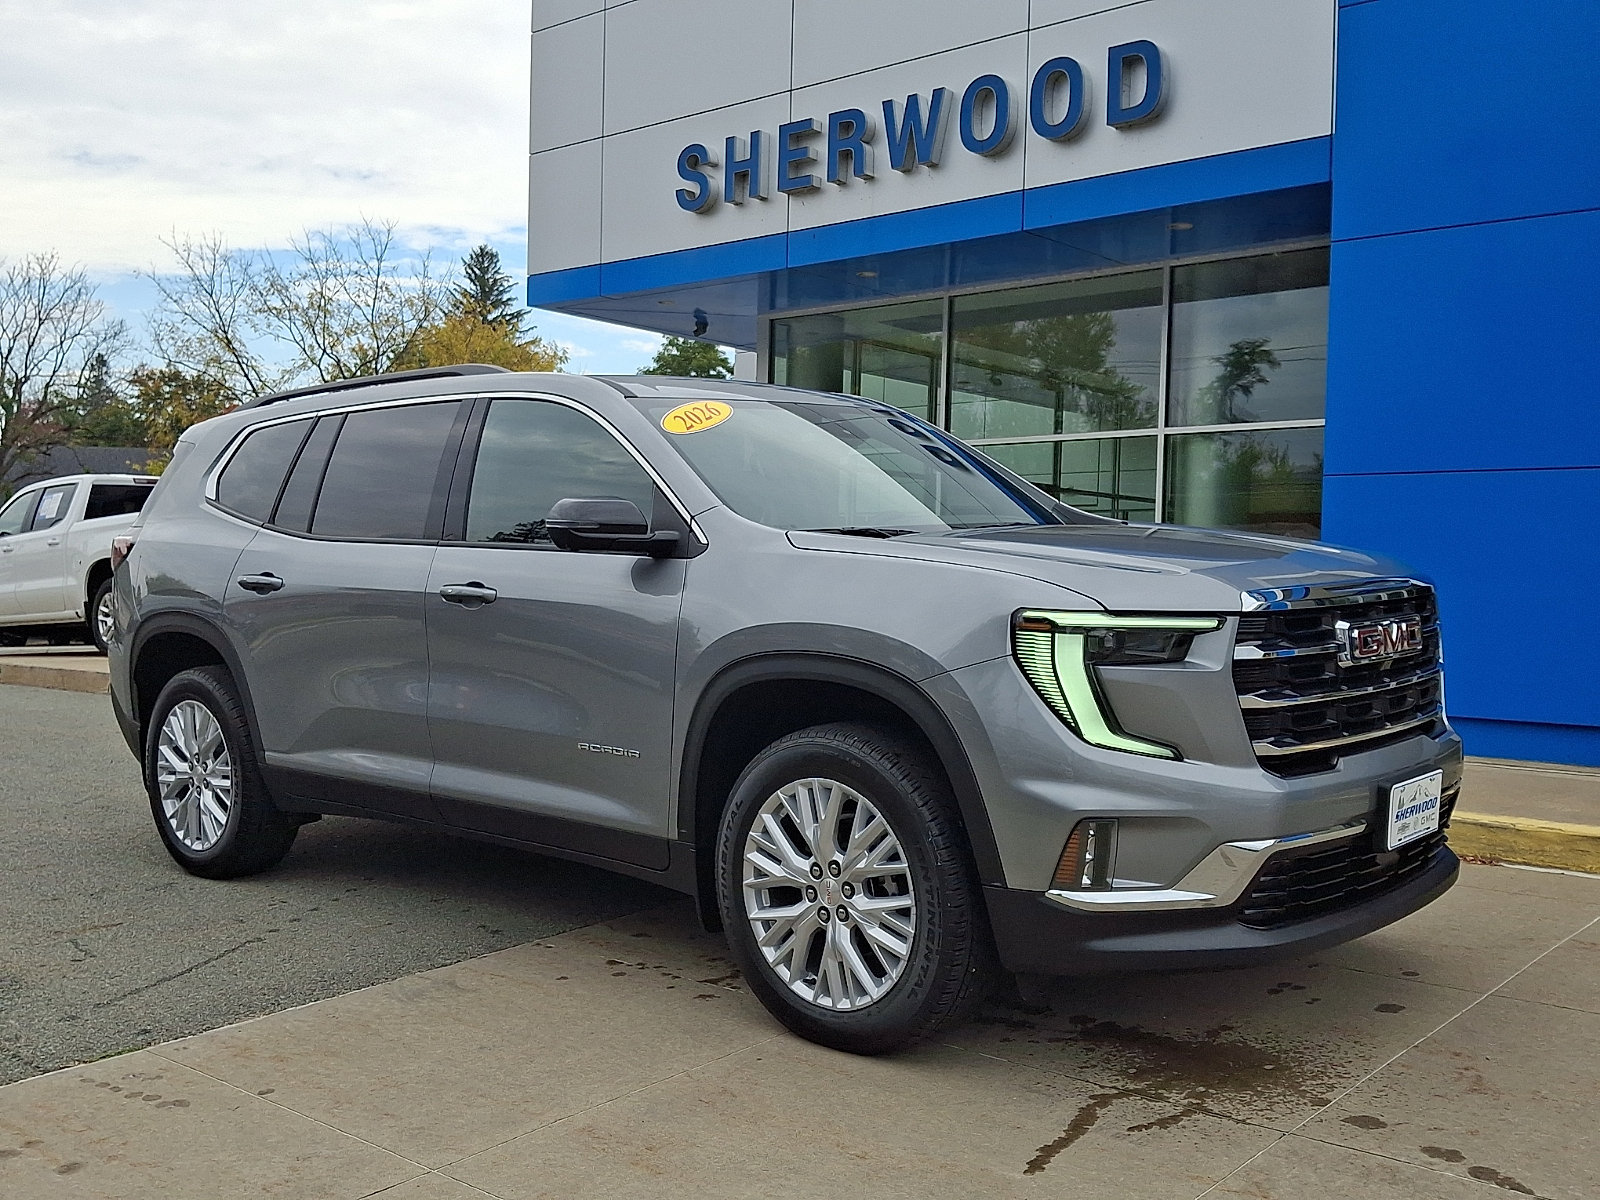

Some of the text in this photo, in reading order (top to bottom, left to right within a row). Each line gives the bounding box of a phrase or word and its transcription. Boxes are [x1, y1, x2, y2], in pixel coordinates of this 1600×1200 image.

[675, 39, 1168, 215] SHERWOOD
[673, 402, 721, 430] 2026
[1356, 621, 1422, 657] GMC
[577, 742, 641, 758] ACADIA
[1394, 796, 1438, 823] SHERWOOD
[1420, 812, 1436, 826] GMC
[721, 799, 744, 932] NTINENTAL
